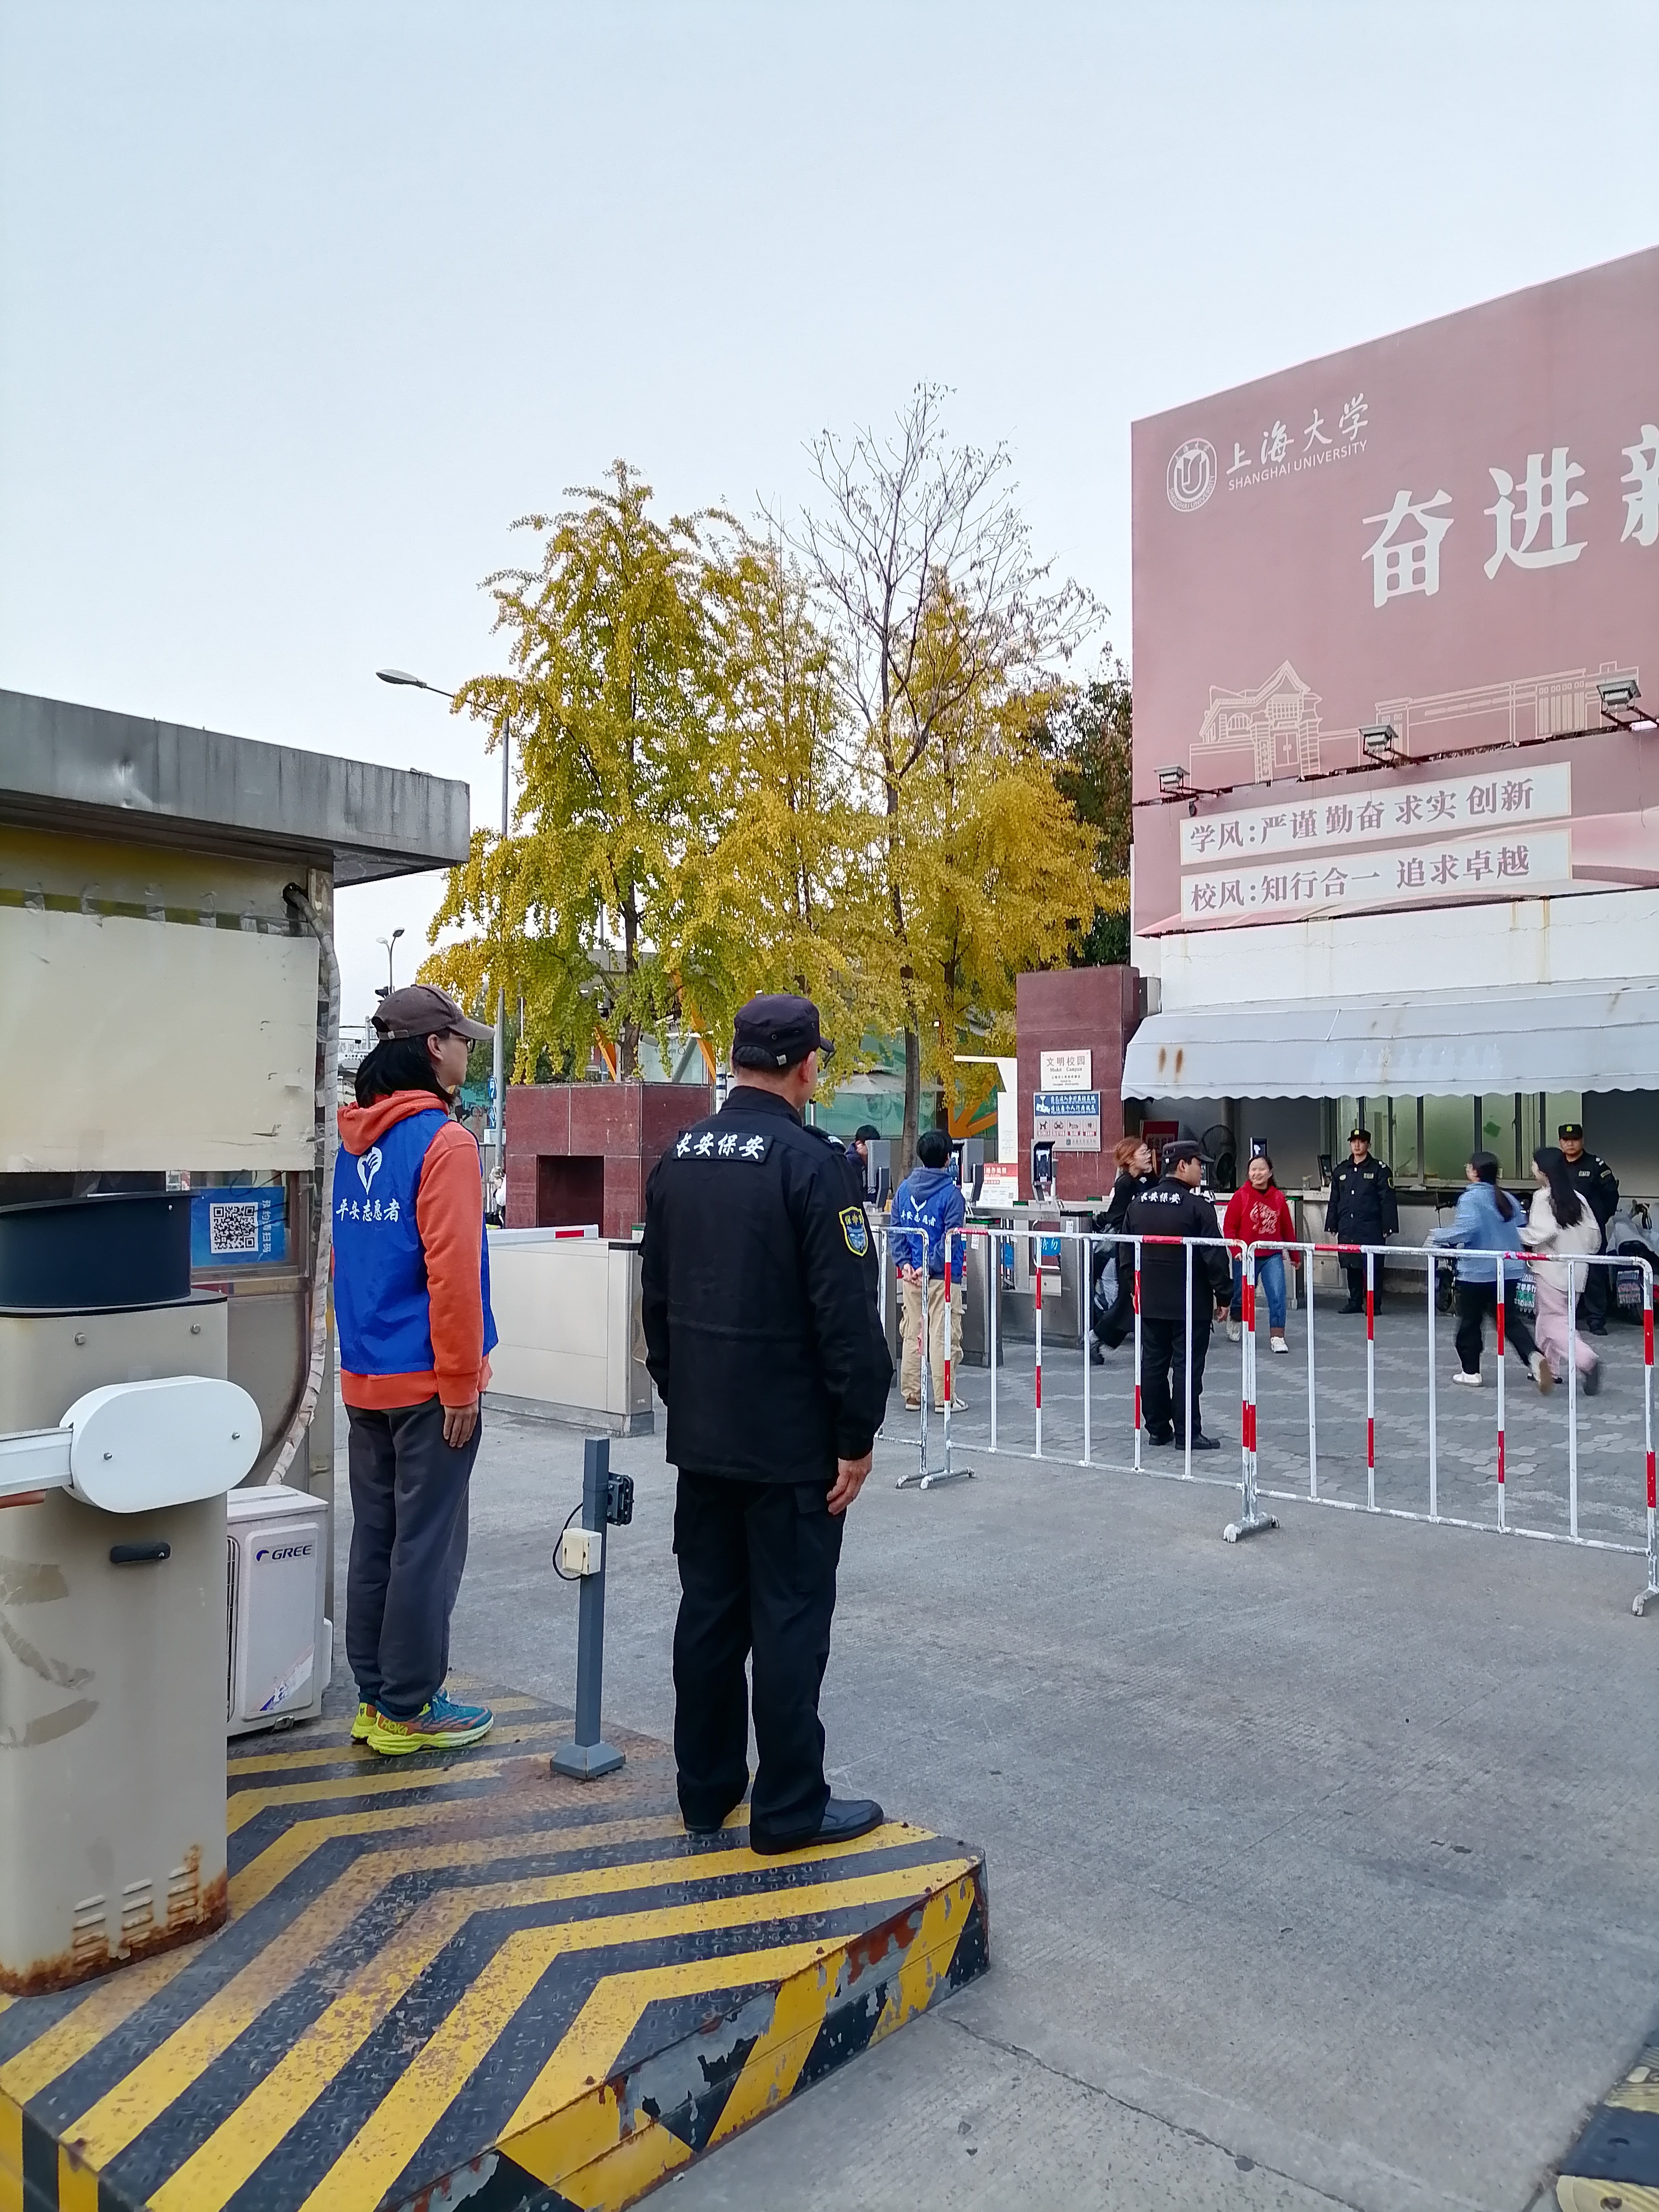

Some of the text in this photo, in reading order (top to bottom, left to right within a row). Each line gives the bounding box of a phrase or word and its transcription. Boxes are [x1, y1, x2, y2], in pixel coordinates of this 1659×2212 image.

[1226, 393, 1369, 474] 上海大学
[1228, 440, 1368, 491] SHANGHAI UNIVERSITY
[1396, 845, 1530, 889] 追求卓越
[1046, 1056, 1086, 1067] 文明校园
[676, 1131, 765, 1160] 长安保安
[335, 1198, 401, 1223] 平安志愿者
[272, 1545, 312, 1560] GREE
[380, 1719, 408, 1737] HOKA
